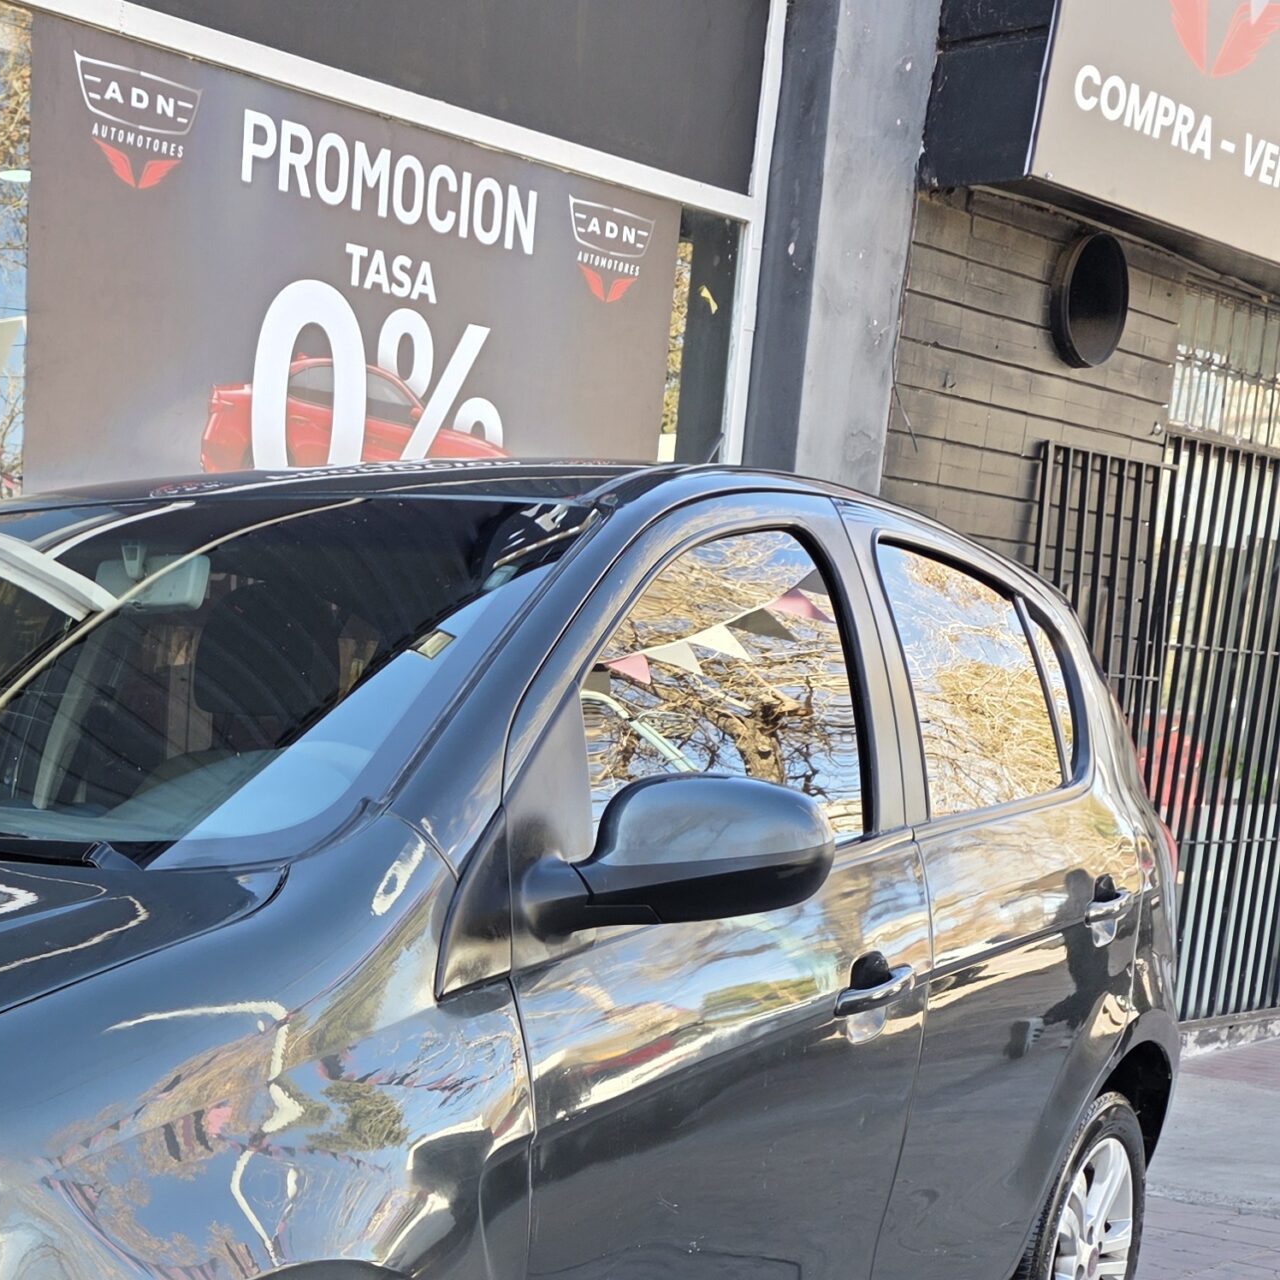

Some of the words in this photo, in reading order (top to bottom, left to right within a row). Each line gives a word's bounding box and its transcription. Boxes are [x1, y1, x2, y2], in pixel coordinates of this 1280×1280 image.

[103, 80, 175, 118] ADN
[91, 122, 184, 158] AUTOMOTORES
[1074, 64, 1212, 161] COMPRA
[1243, 132, 1280, 189] VE
[240, 108, 538, 256] PROMOCION
[586, 216, 636, 245] ADN
[345, 242, 437, 304] TASA
[577, 250, 640, 277] AUTOMOTORES
